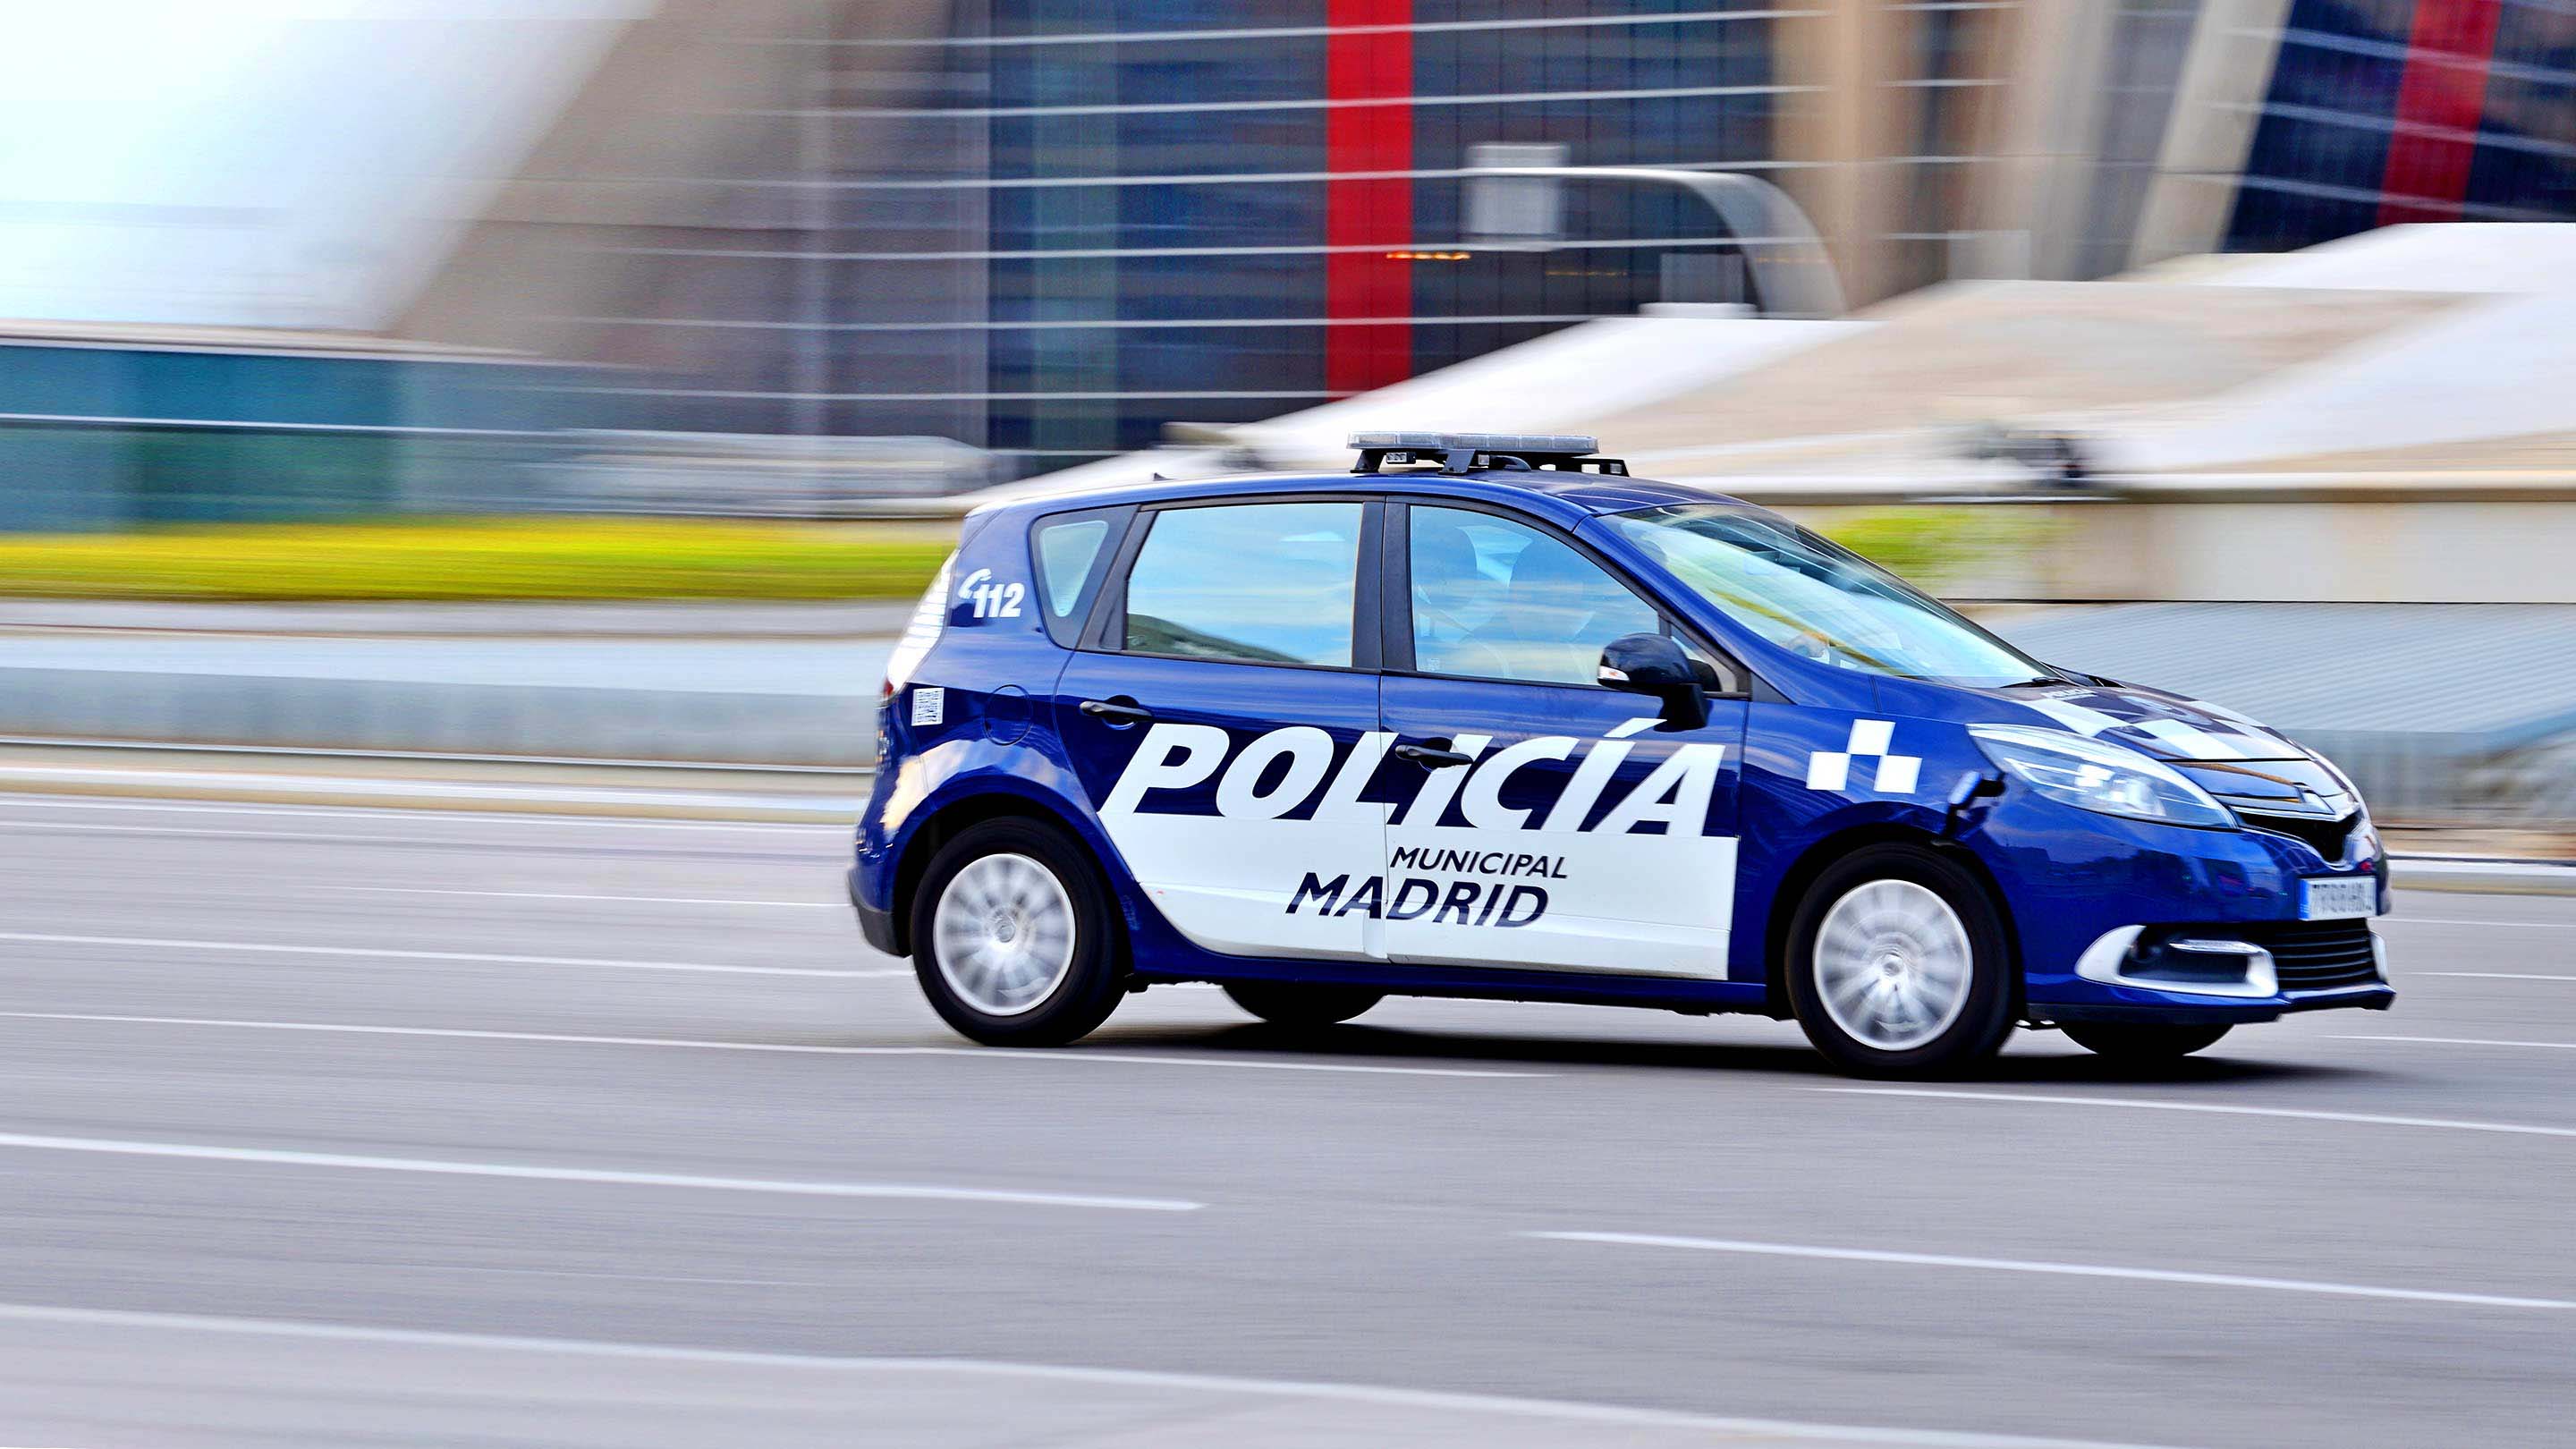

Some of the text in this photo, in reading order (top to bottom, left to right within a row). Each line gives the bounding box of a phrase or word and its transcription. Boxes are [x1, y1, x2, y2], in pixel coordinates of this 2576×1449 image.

[972, 582, 1025, 618] 112
[1097, 717, 1726, 836] POLICÍA
[1390, 845, 1569, 879] MUNICIPAL
[1285, 871, 1549, 928] MADRID
